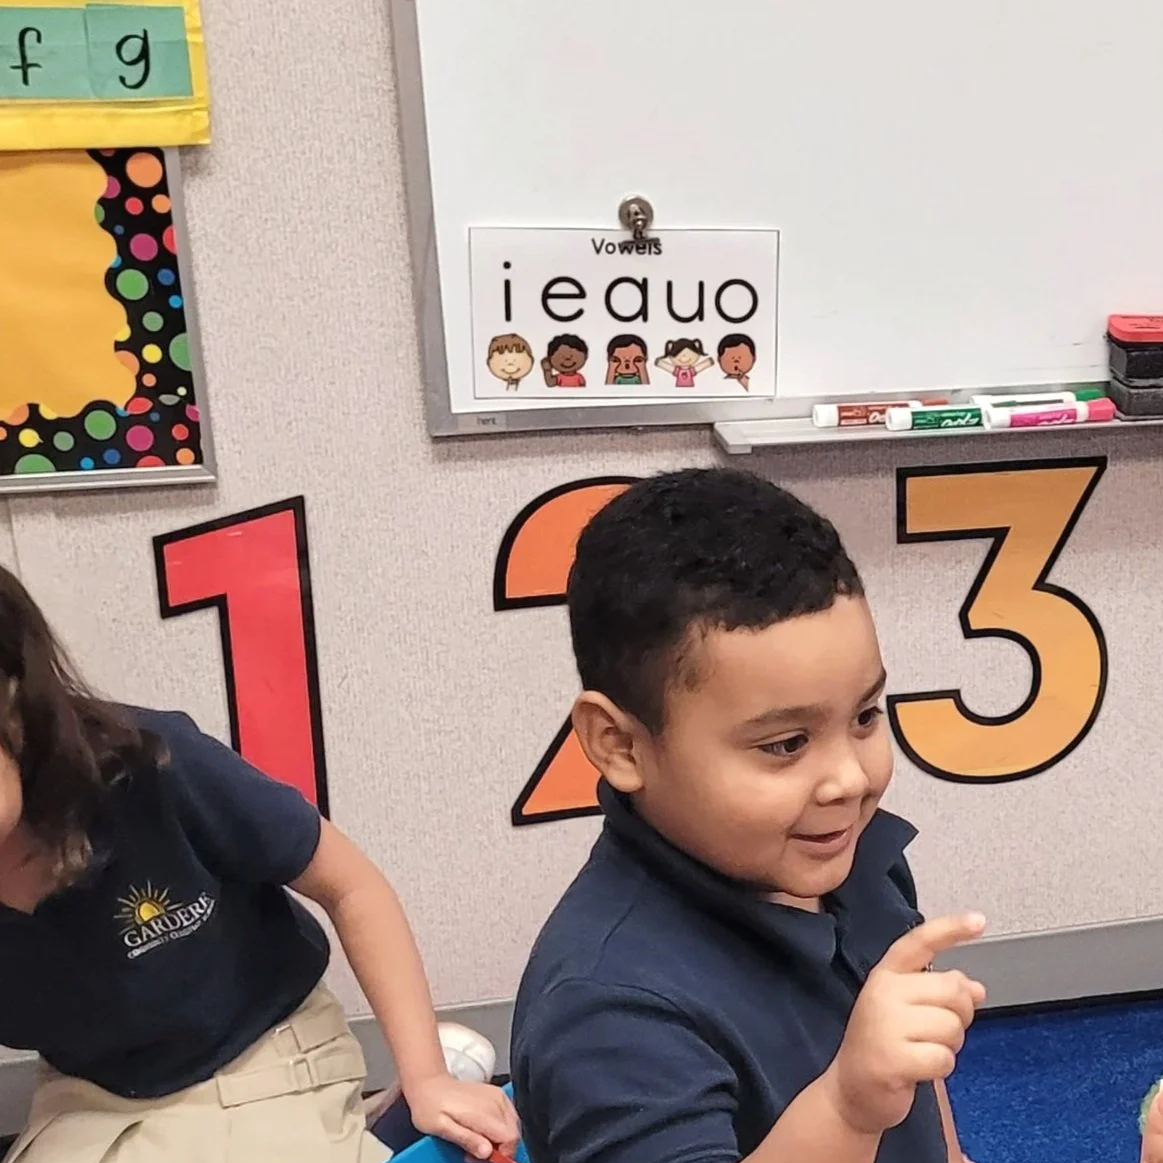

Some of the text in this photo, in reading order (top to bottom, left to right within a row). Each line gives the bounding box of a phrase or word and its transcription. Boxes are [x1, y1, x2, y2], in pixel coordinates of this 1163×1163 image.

[10, 27, 150, 89] f g
[588, 238, 662, 255] Vowels
[503, 261, 758, 323] i e a u o
[153, 495, 328, 820] 1
[887, 456, 1108, 784] 3
